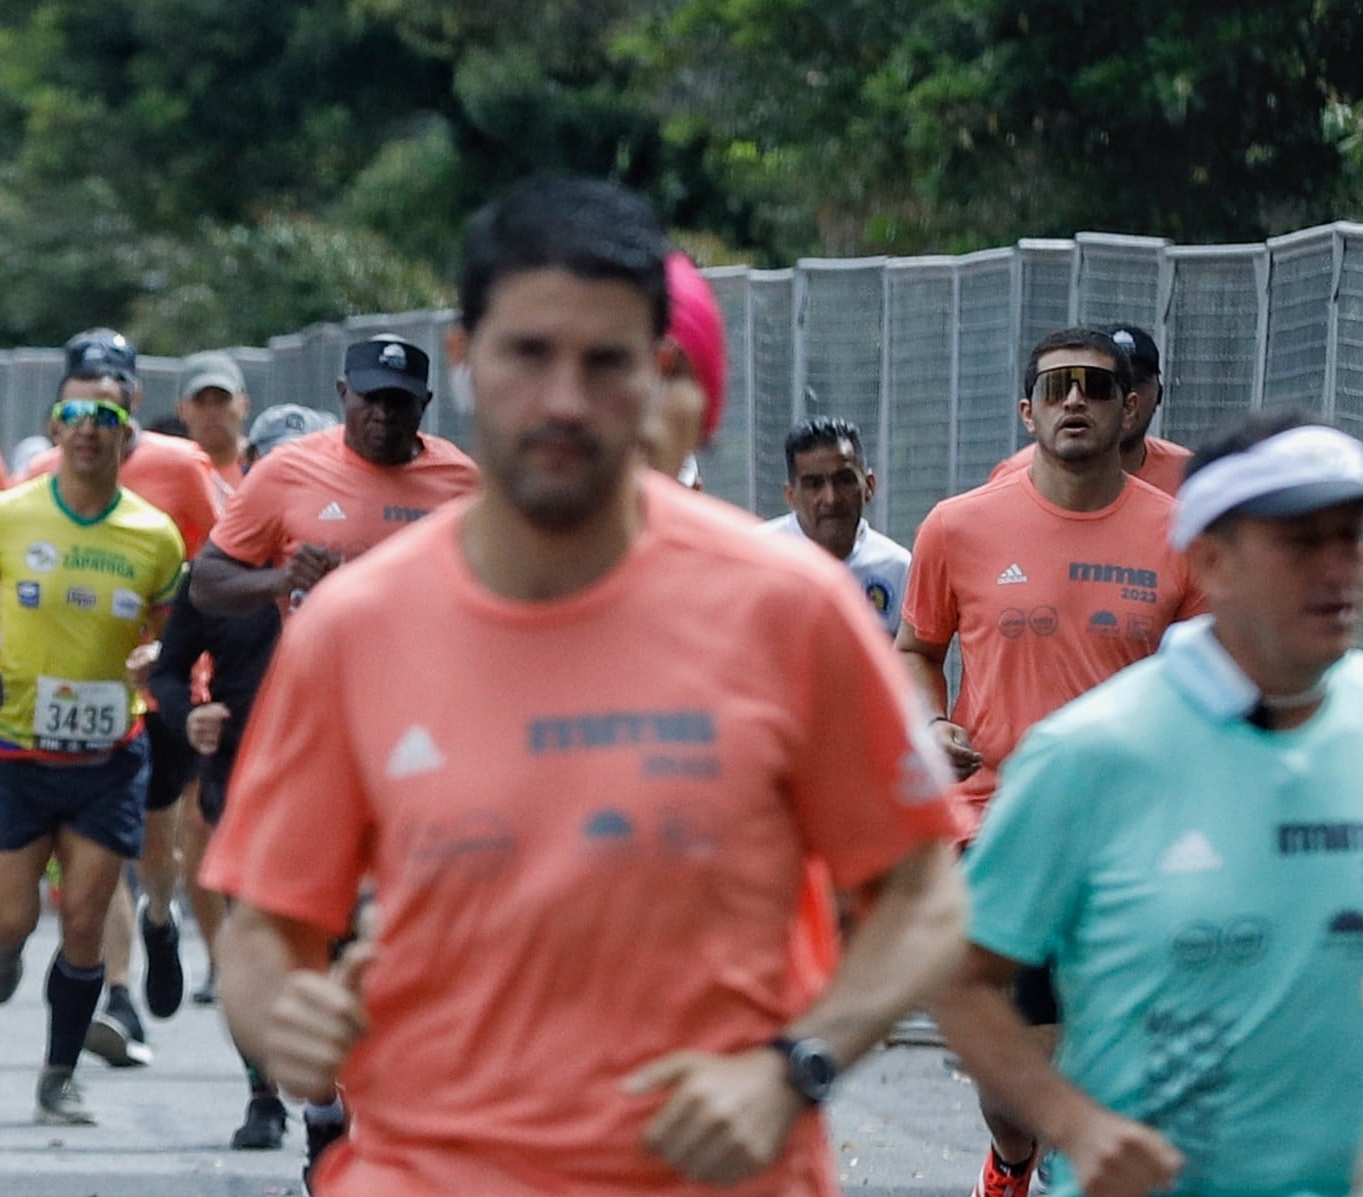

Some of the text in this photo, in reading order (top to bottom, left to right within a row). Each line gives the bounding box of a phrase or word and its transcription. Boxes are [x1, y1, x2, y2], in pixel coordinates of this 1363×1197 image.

[1069, 562, 1157, 588] mmB
[1121, 587, 1157, 603] 2023
[46, 703, 115, 736] 3435
